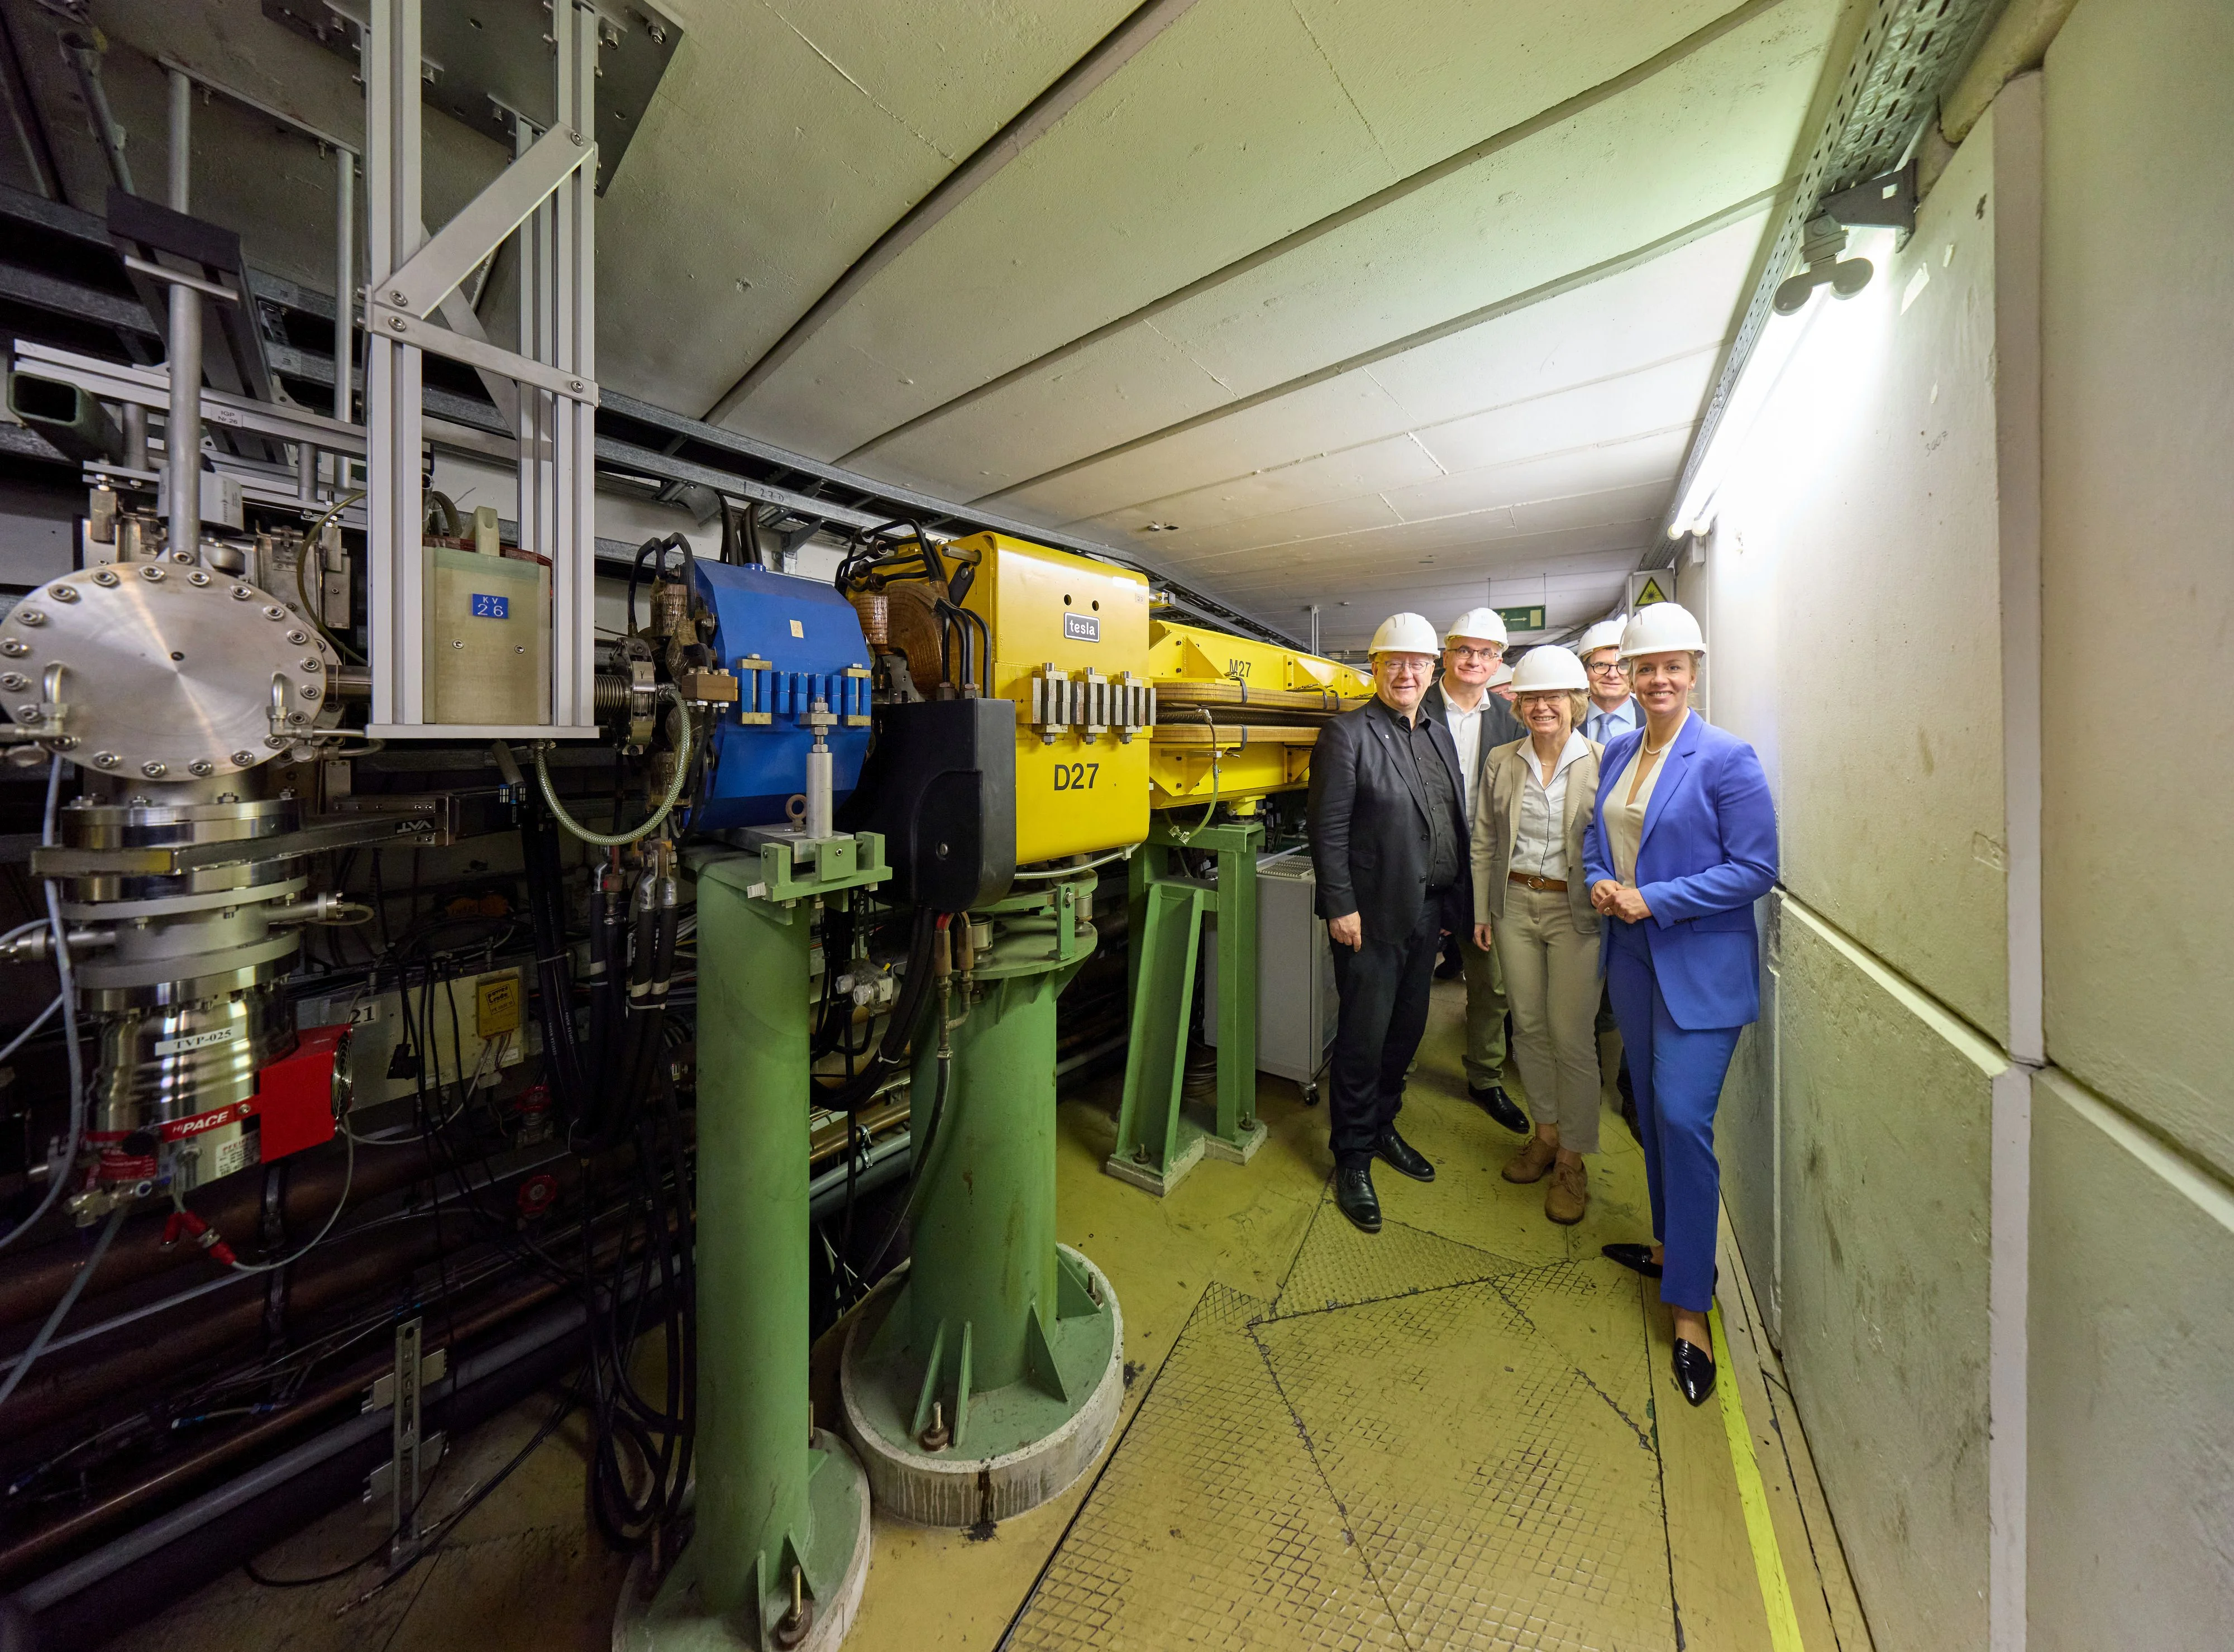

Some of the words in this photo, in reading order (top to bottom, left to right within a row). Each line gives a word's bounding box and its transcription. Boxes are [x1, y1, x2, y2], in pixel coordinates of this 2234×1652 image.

[1069, 619, 1095, 636] tesla
[1229, 658, 1251, 677] M27
[1054, 763, 1099, 791] D27
[397, 819, 432, 834] VAT
[351, 1006, 374, 1025] 21
[174, 1029, 232, 1049] TVP-025
